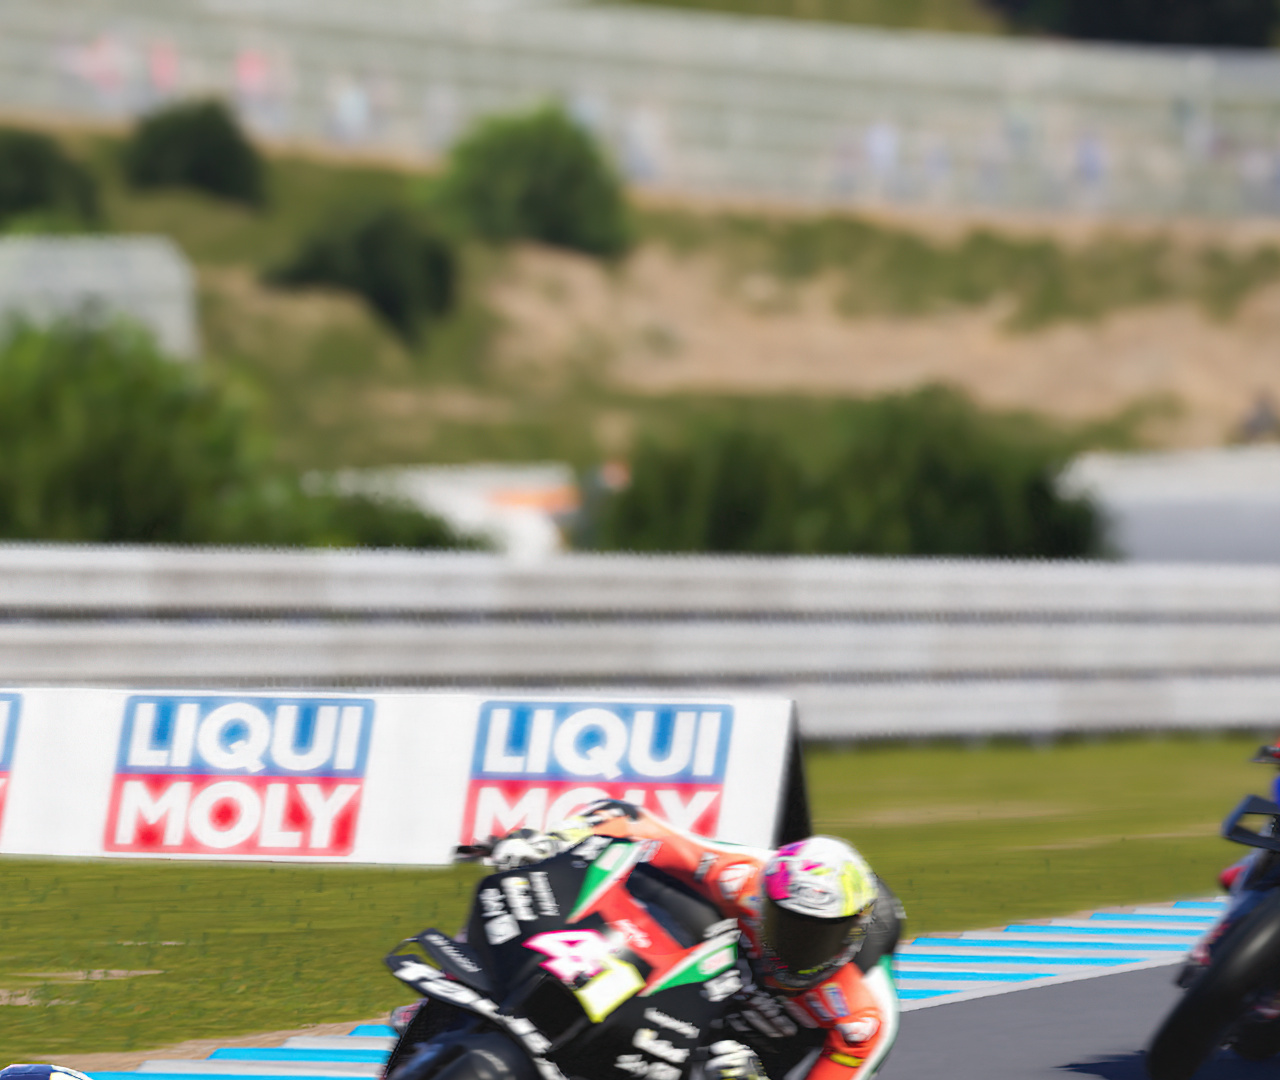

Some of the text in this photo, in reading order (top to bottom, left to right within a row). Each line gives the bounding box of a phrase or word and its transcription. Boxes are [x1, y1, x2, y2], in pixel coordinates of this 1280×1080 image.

[127, 702, 364, 772] LIQUI
[483, 707, 722, 780] LIQUI
[114, 780, 361, 849] MOLY
[473, 786, 720, 839] MOY
[522, 930, 647, 1023] 41
